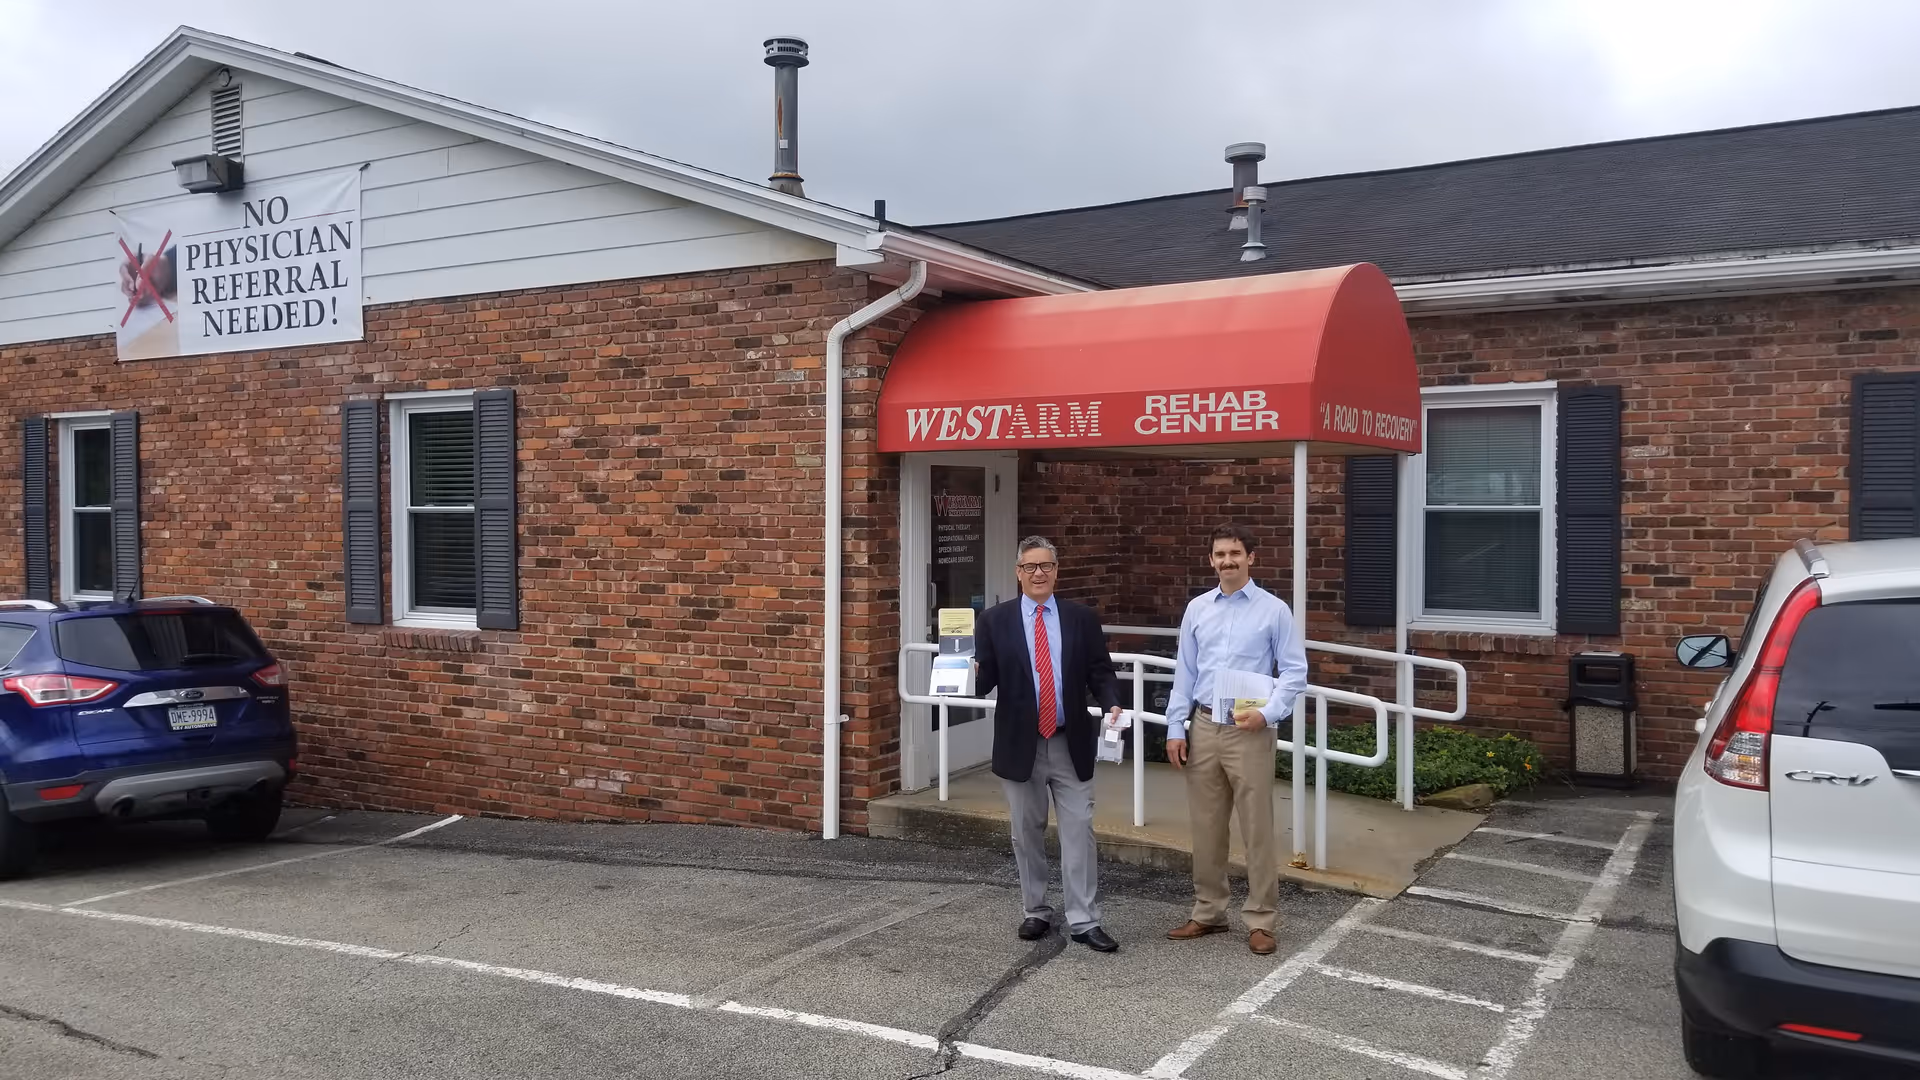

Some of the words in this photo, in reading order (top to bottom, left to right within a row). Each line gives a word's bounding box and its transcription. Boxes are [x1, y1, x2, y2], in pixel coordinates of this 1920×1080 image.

[243, 196, 289, 229] NO
[186, 221, 353, 271] PHYSICIAN
[192, 260, 348, 305] REFERRAL
[203, 296, 338, 337] NEEDED!
[1145, 390, 1267, 414] REHAB
[906, 401, 1102, 442] WESTARM
[1134, 410, 1279, 435] CENTER
[1333, 404, 1359, 434] ROAD
[1361, 409, 1373, 437] TO
[1785, 769, 1878, 787] CR-V
